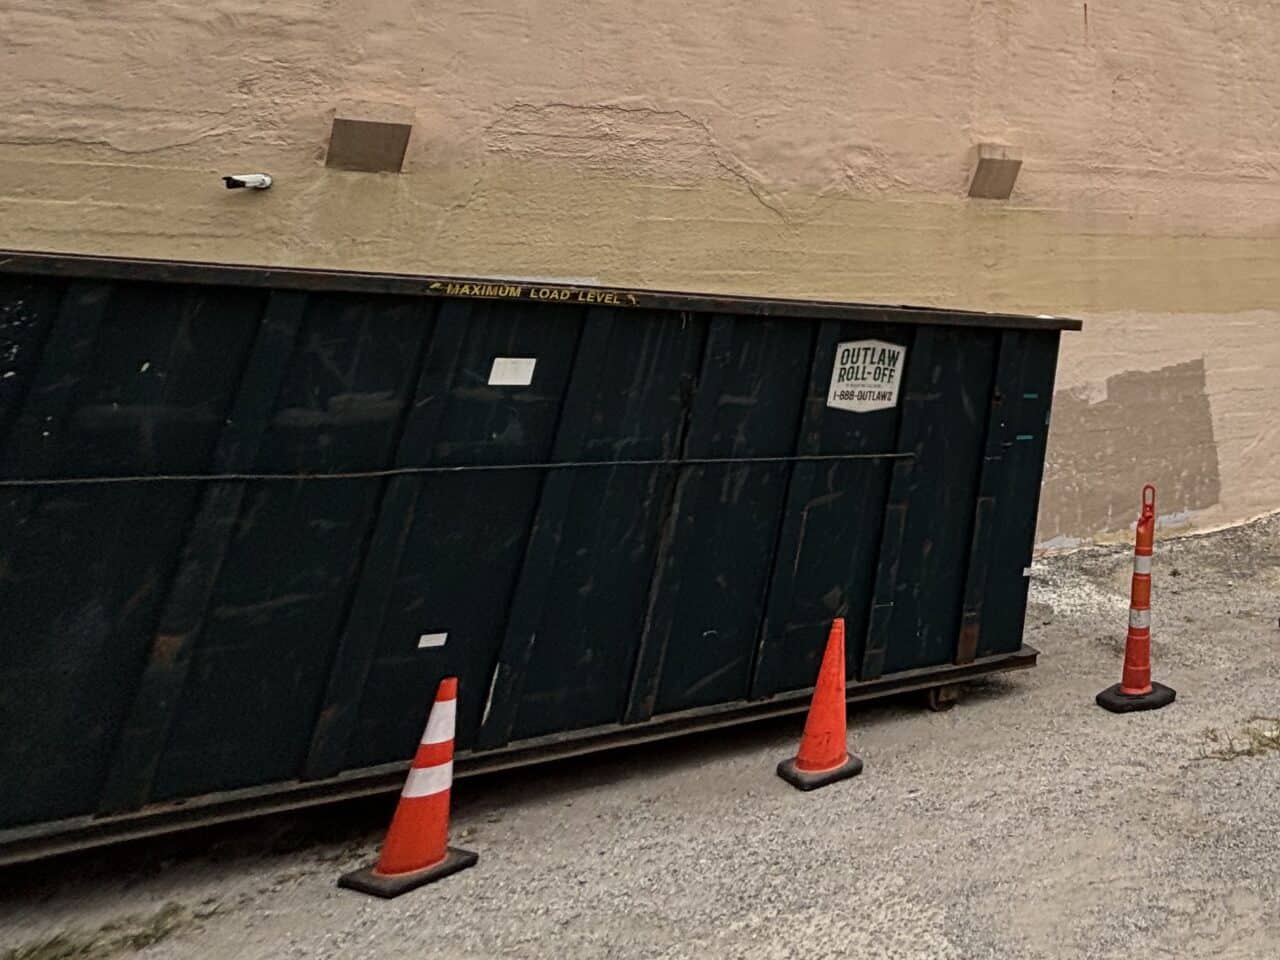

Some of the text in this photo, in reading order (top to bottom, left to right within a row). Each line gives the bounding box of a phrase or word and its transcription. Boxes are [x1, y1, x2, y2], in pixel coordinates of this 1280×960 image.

[446, 283, 621, 305] MAXIMUM LOAD LEVEL
[840, 347, 901, 368] OUTLAW
[838, 365, 896, 384] ROLL-OFF
